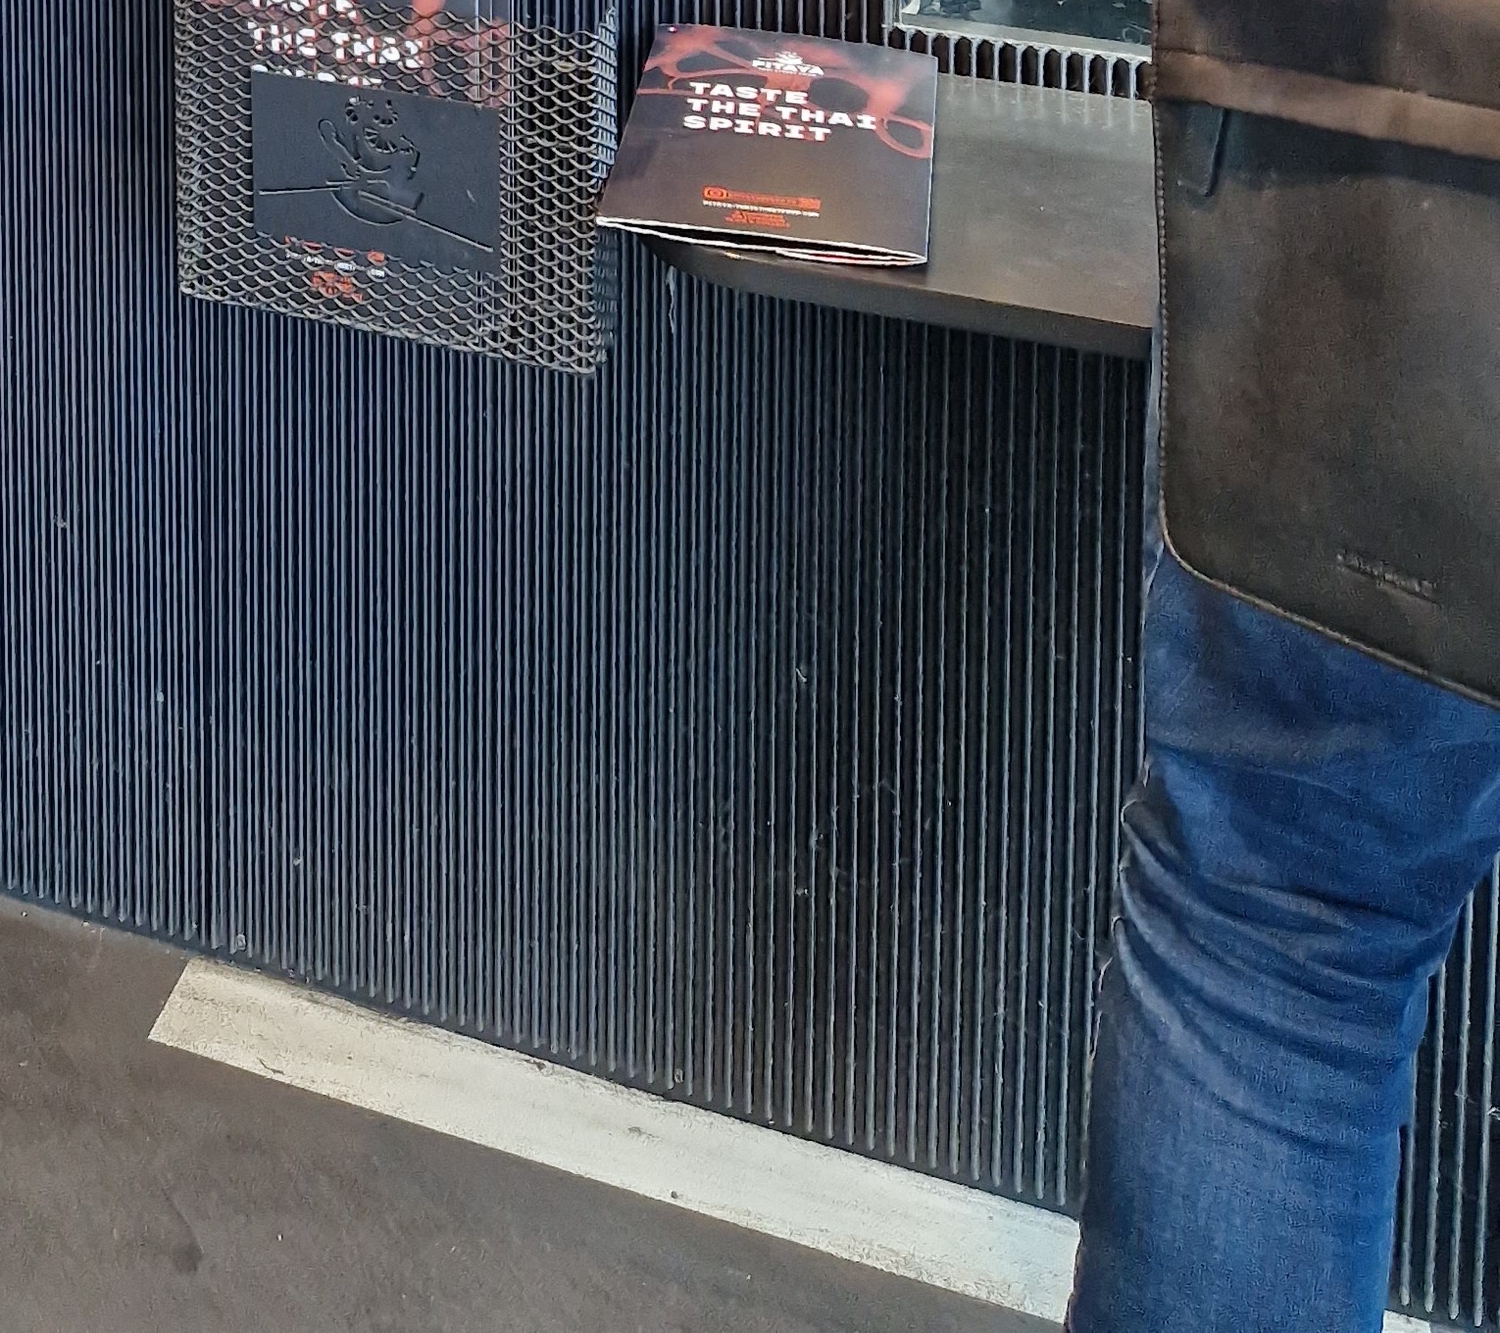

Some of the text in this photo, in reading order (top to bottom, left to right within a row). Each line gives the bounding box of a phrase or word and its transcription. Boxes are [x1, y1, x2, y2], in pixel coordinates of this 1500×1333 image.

[752, 59, 825, 76] PITAYA
[689, 82, 809, 105] TASTE
[686, 98, 877, 130] THE THAI
[683, 115, 832, 142] SPIRIT
